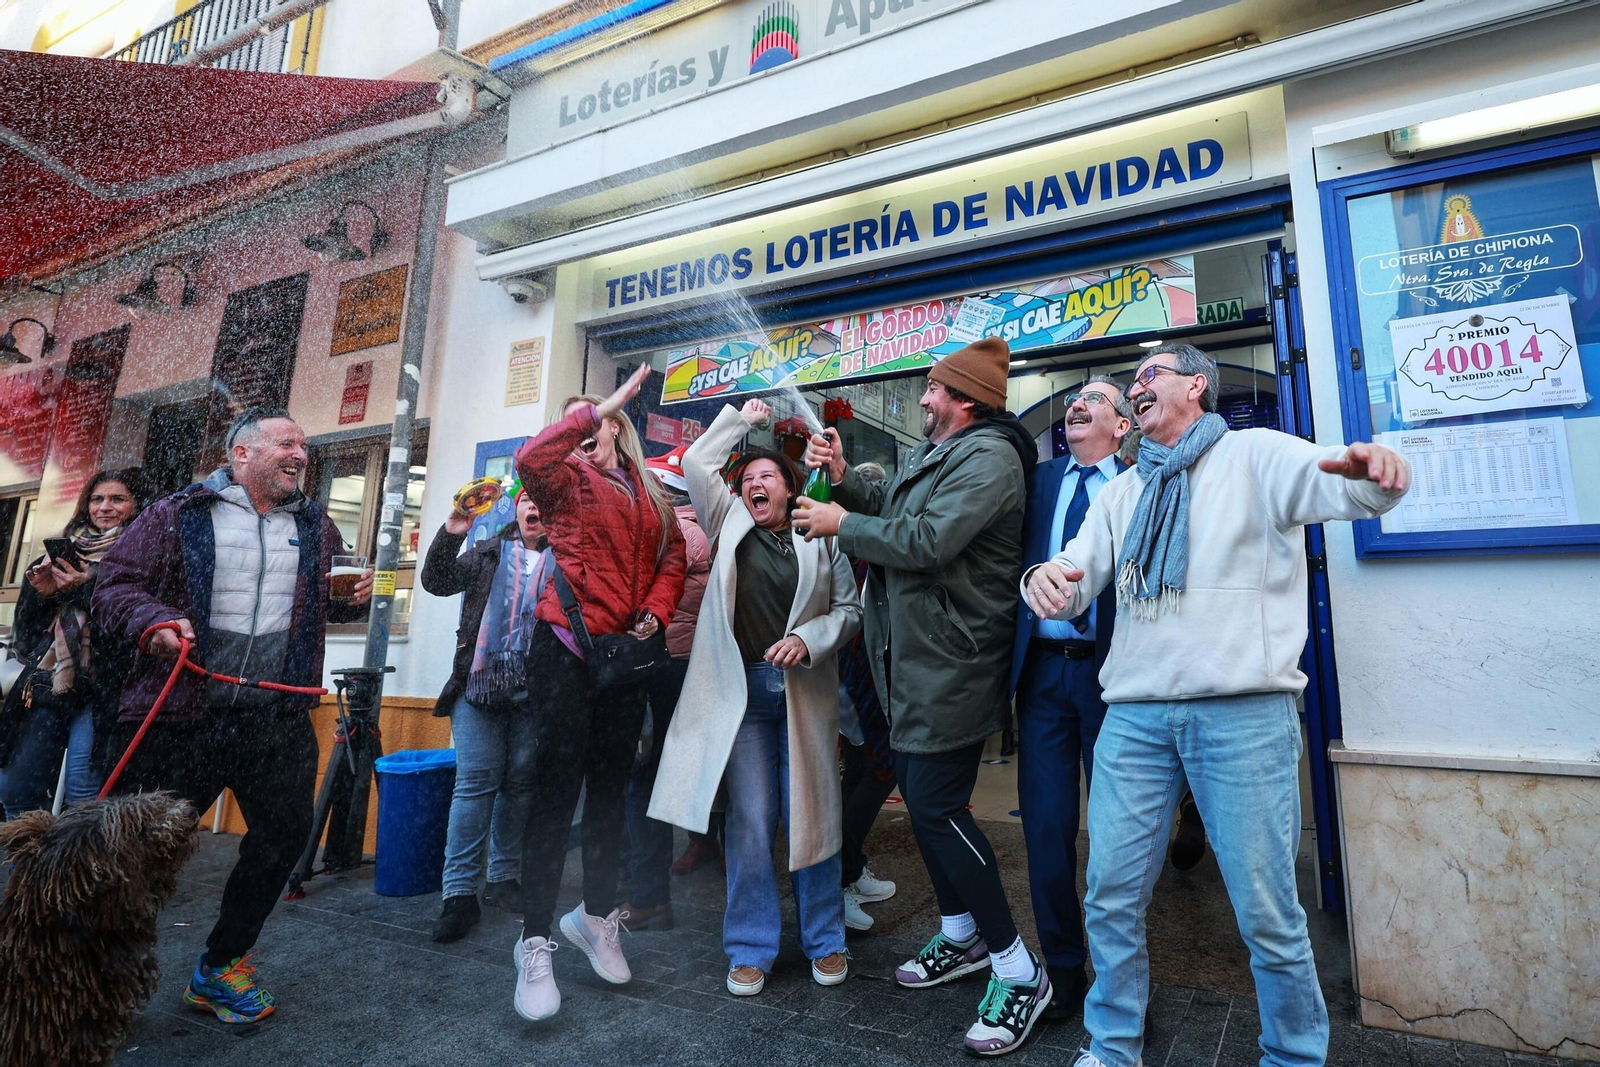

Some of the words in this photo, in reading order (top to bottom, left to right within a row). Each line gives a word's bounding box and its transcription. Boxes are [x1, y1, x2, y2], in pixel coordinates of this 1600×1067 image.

[558, 60, 696, 128] Loterías
[708, 45, 730, 86] y
[605, 246, 753, 308] TENEMOS
[766, 203, 920, 275] LOTERÍA
[932, 192, 988, 237] DE
[1004, 138, 1224, 221] NAVIDAD
[1379, 249, 1444, 270] LOTERÍA
[1449, 247, 1470, 258] DE
[1474, 233, 1554, 255] CHIPIONA
[1389, 273, 1432, 289] Ntra.
[1434, 266, 1473, 282] Sra.
[1479, 261, 1495, 274] de
[1499, 254, 1549, 273] Regla
[841, 328, 864, 353] EL
[866, 301, 943, 344] GORDO
[1022, 302, 1061, 335] CAE
[1063, 269, 1151, 322] AQUÍ?
[719, 357, 748, 382] CAE
[749, 329, 813, 373] AQUÍ?
[841, 353, 863, 375] DE
[866, 325, 948, 367] NAVIDAD
[1424, 334, 1543, 376] 40014
[1458, 326, 1510, 341] PREMIO
[1449, 372, 1494, 382] VENDIDO
[1497, 365, 1523, 376] AQUÍ
